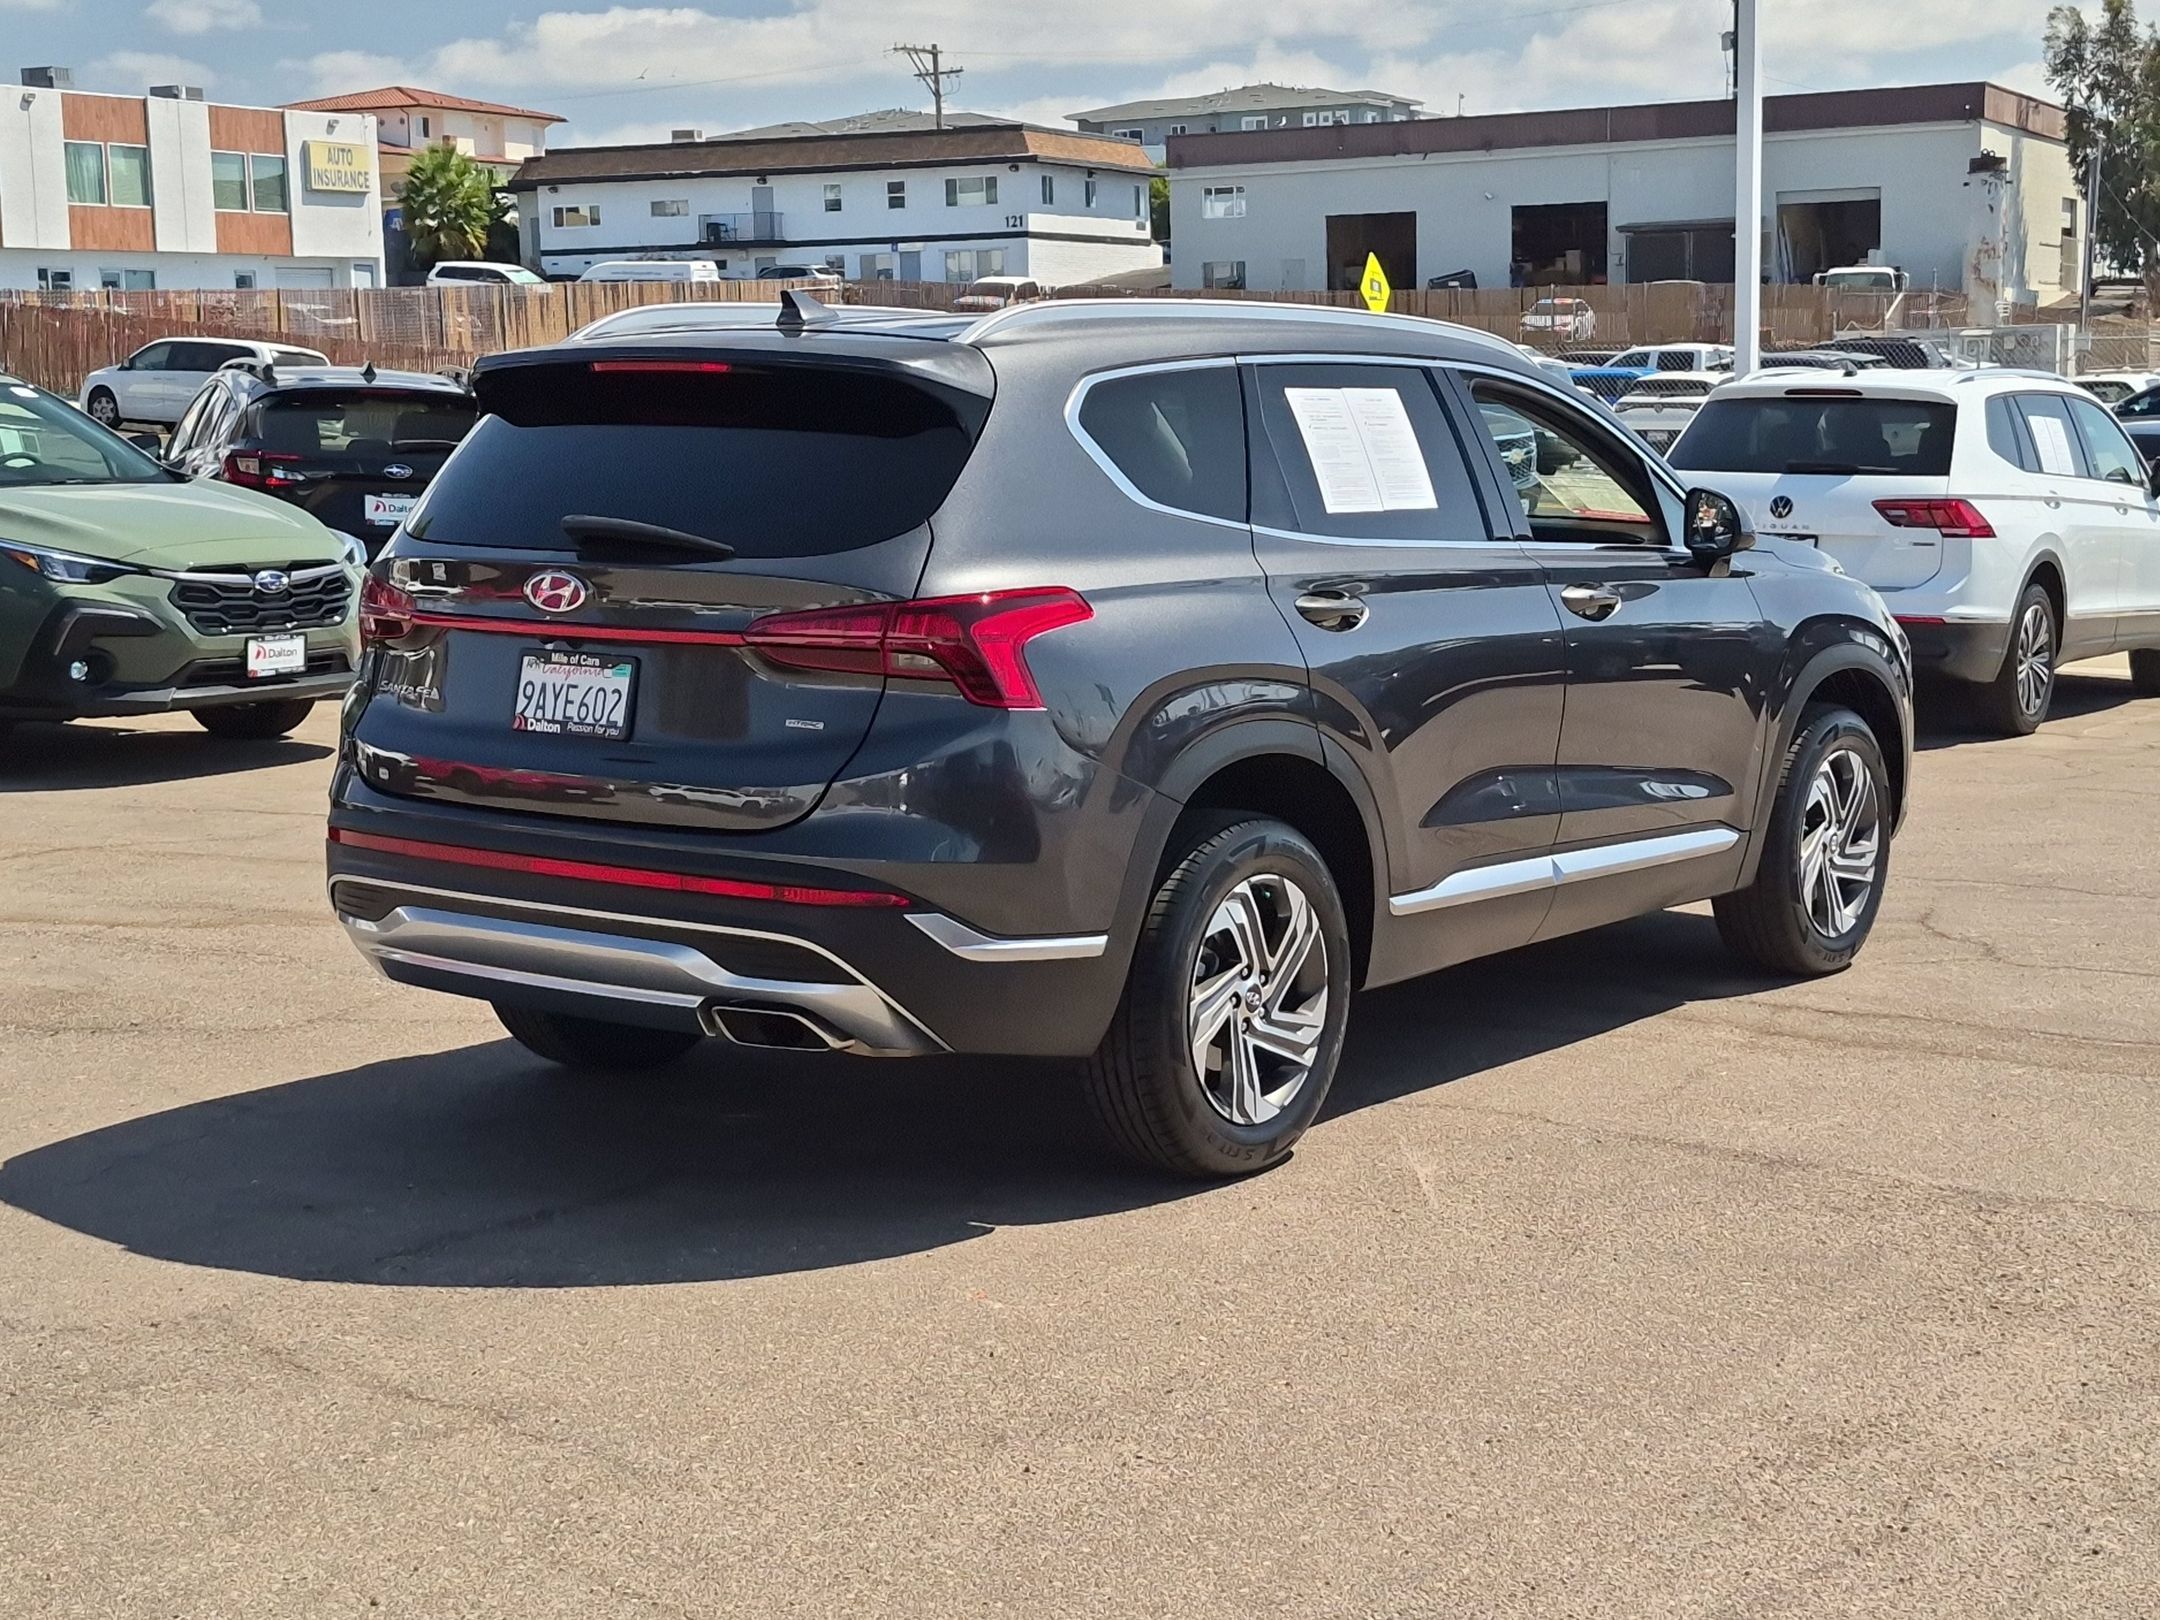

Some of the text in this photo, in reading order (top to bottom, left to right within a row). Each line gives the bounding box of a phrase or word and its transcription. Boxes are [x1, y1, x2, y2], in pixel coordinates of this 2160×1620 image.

[327, 147, 353, 166] AUTO
[313, 168, 370, 189] INSURANCE
[1005, 214, 1023, 228] 121
[268, 646, 298, 659] Dalton
[551, 652, 600, 666] Mile of Cars
[542, 663, 605, 681] California
[520, 680, 623, 725] 9AYE602
[527, 718, 561, 734] Dalton
[566, 721, 620, 738] Passion for you
